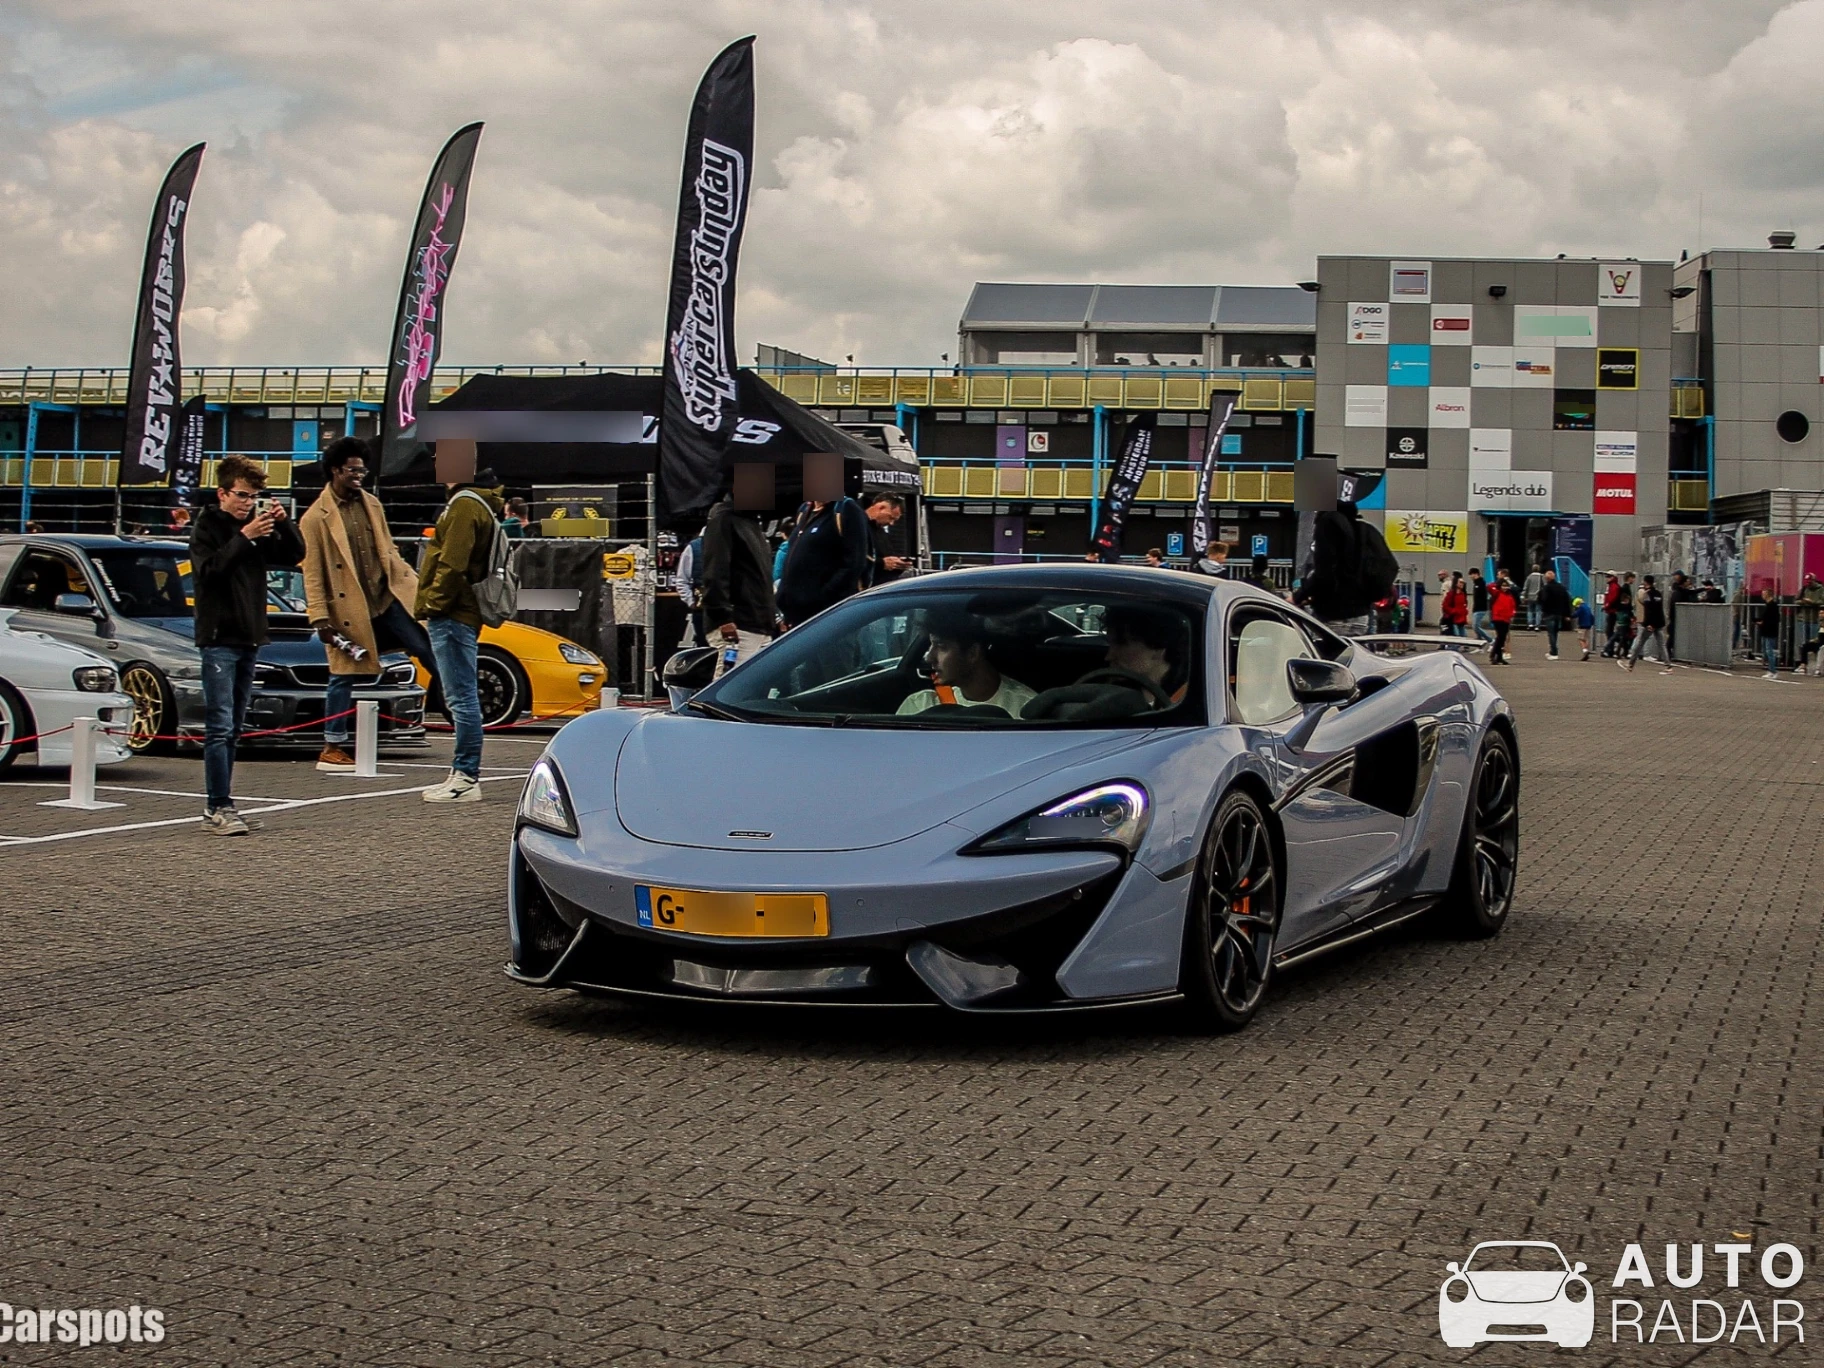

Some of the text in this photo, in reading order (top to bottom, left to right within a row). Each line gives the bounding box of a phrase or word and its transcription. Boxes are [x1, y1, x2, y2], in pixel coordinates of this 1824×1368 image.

[1124, 429, 1146, 480] AMSTERDAM
[1473, 483, 1547, 498] Legends club
[1595, 488, 1634, 498] MOTUL
[639, 909, 651, 920] NL
